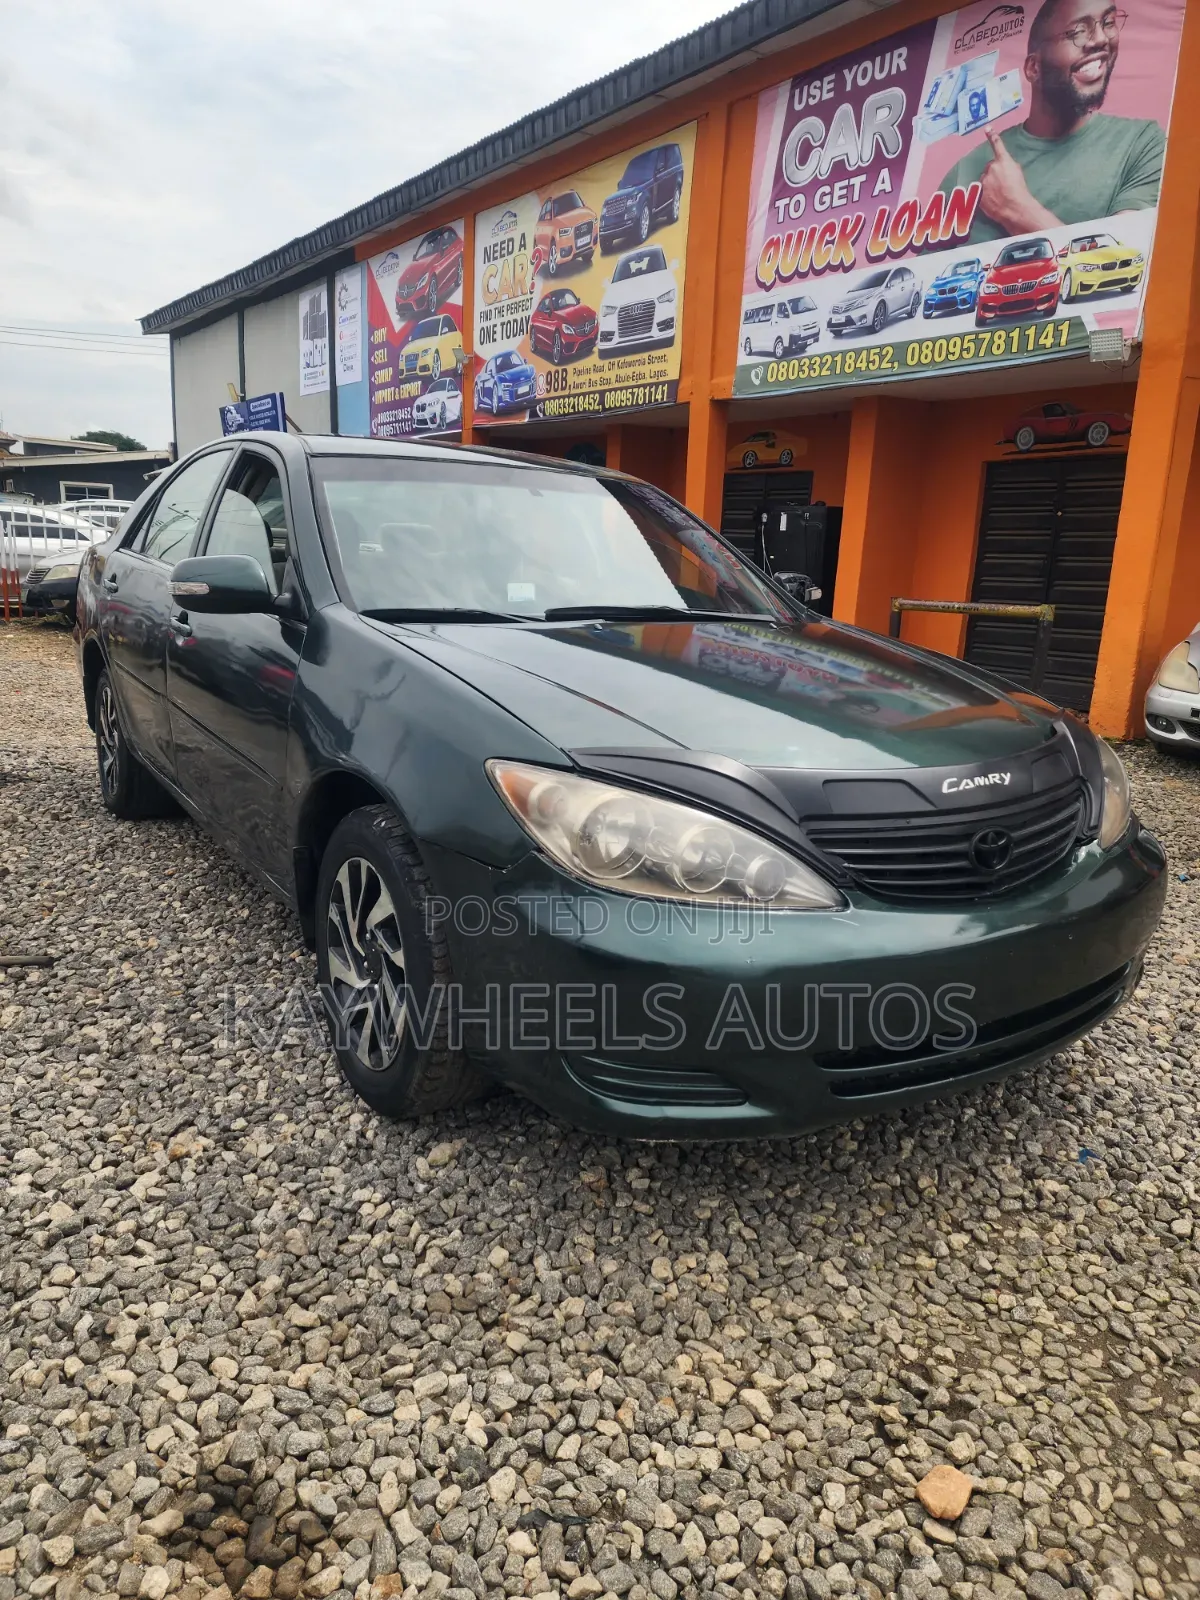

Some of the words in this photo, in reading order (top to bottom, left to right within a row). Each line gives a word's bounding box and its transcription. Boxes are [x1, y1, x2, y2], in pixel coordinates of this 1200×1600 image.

[793, 69, 834, 111] USE
[843, 46, 908, 87] YOUR
[782, 87, 906, 187] CAR
[775, 190, 806, 223] TO
[813, 176, 866, 213] GET
[872, 167, 892, 196] A
[483, 237, 515, 265] NEED
[518, 232, 527, 253] A
[756, 212, 865, 292] QUICK
[866, 182, 982, 262] LOAN
[479, 308, 493, 323] FIND
[494, 305, 505, 320] THE
[506, 297, 533, 317] PERFECT
[374, 327, 387, 344] BUY
[479, 321, 497, 346] ONE
[500, 314, 531, 341] TODAY
[374, 348, 388, 365] SELL
[766, 347, 899, 384] 08033218452,
[906, 319, 1071, 366] 08095781141
[374, 367, 393, 385] SWAP
[588, 377, 598, 387] Bus
[375, 386, 395, 405] IMPORT
[400, 380, 421, 399] EXPORT
[604, 384, 668, 409] 08095781141
[941, 772, 1012, 794] CAMRY
